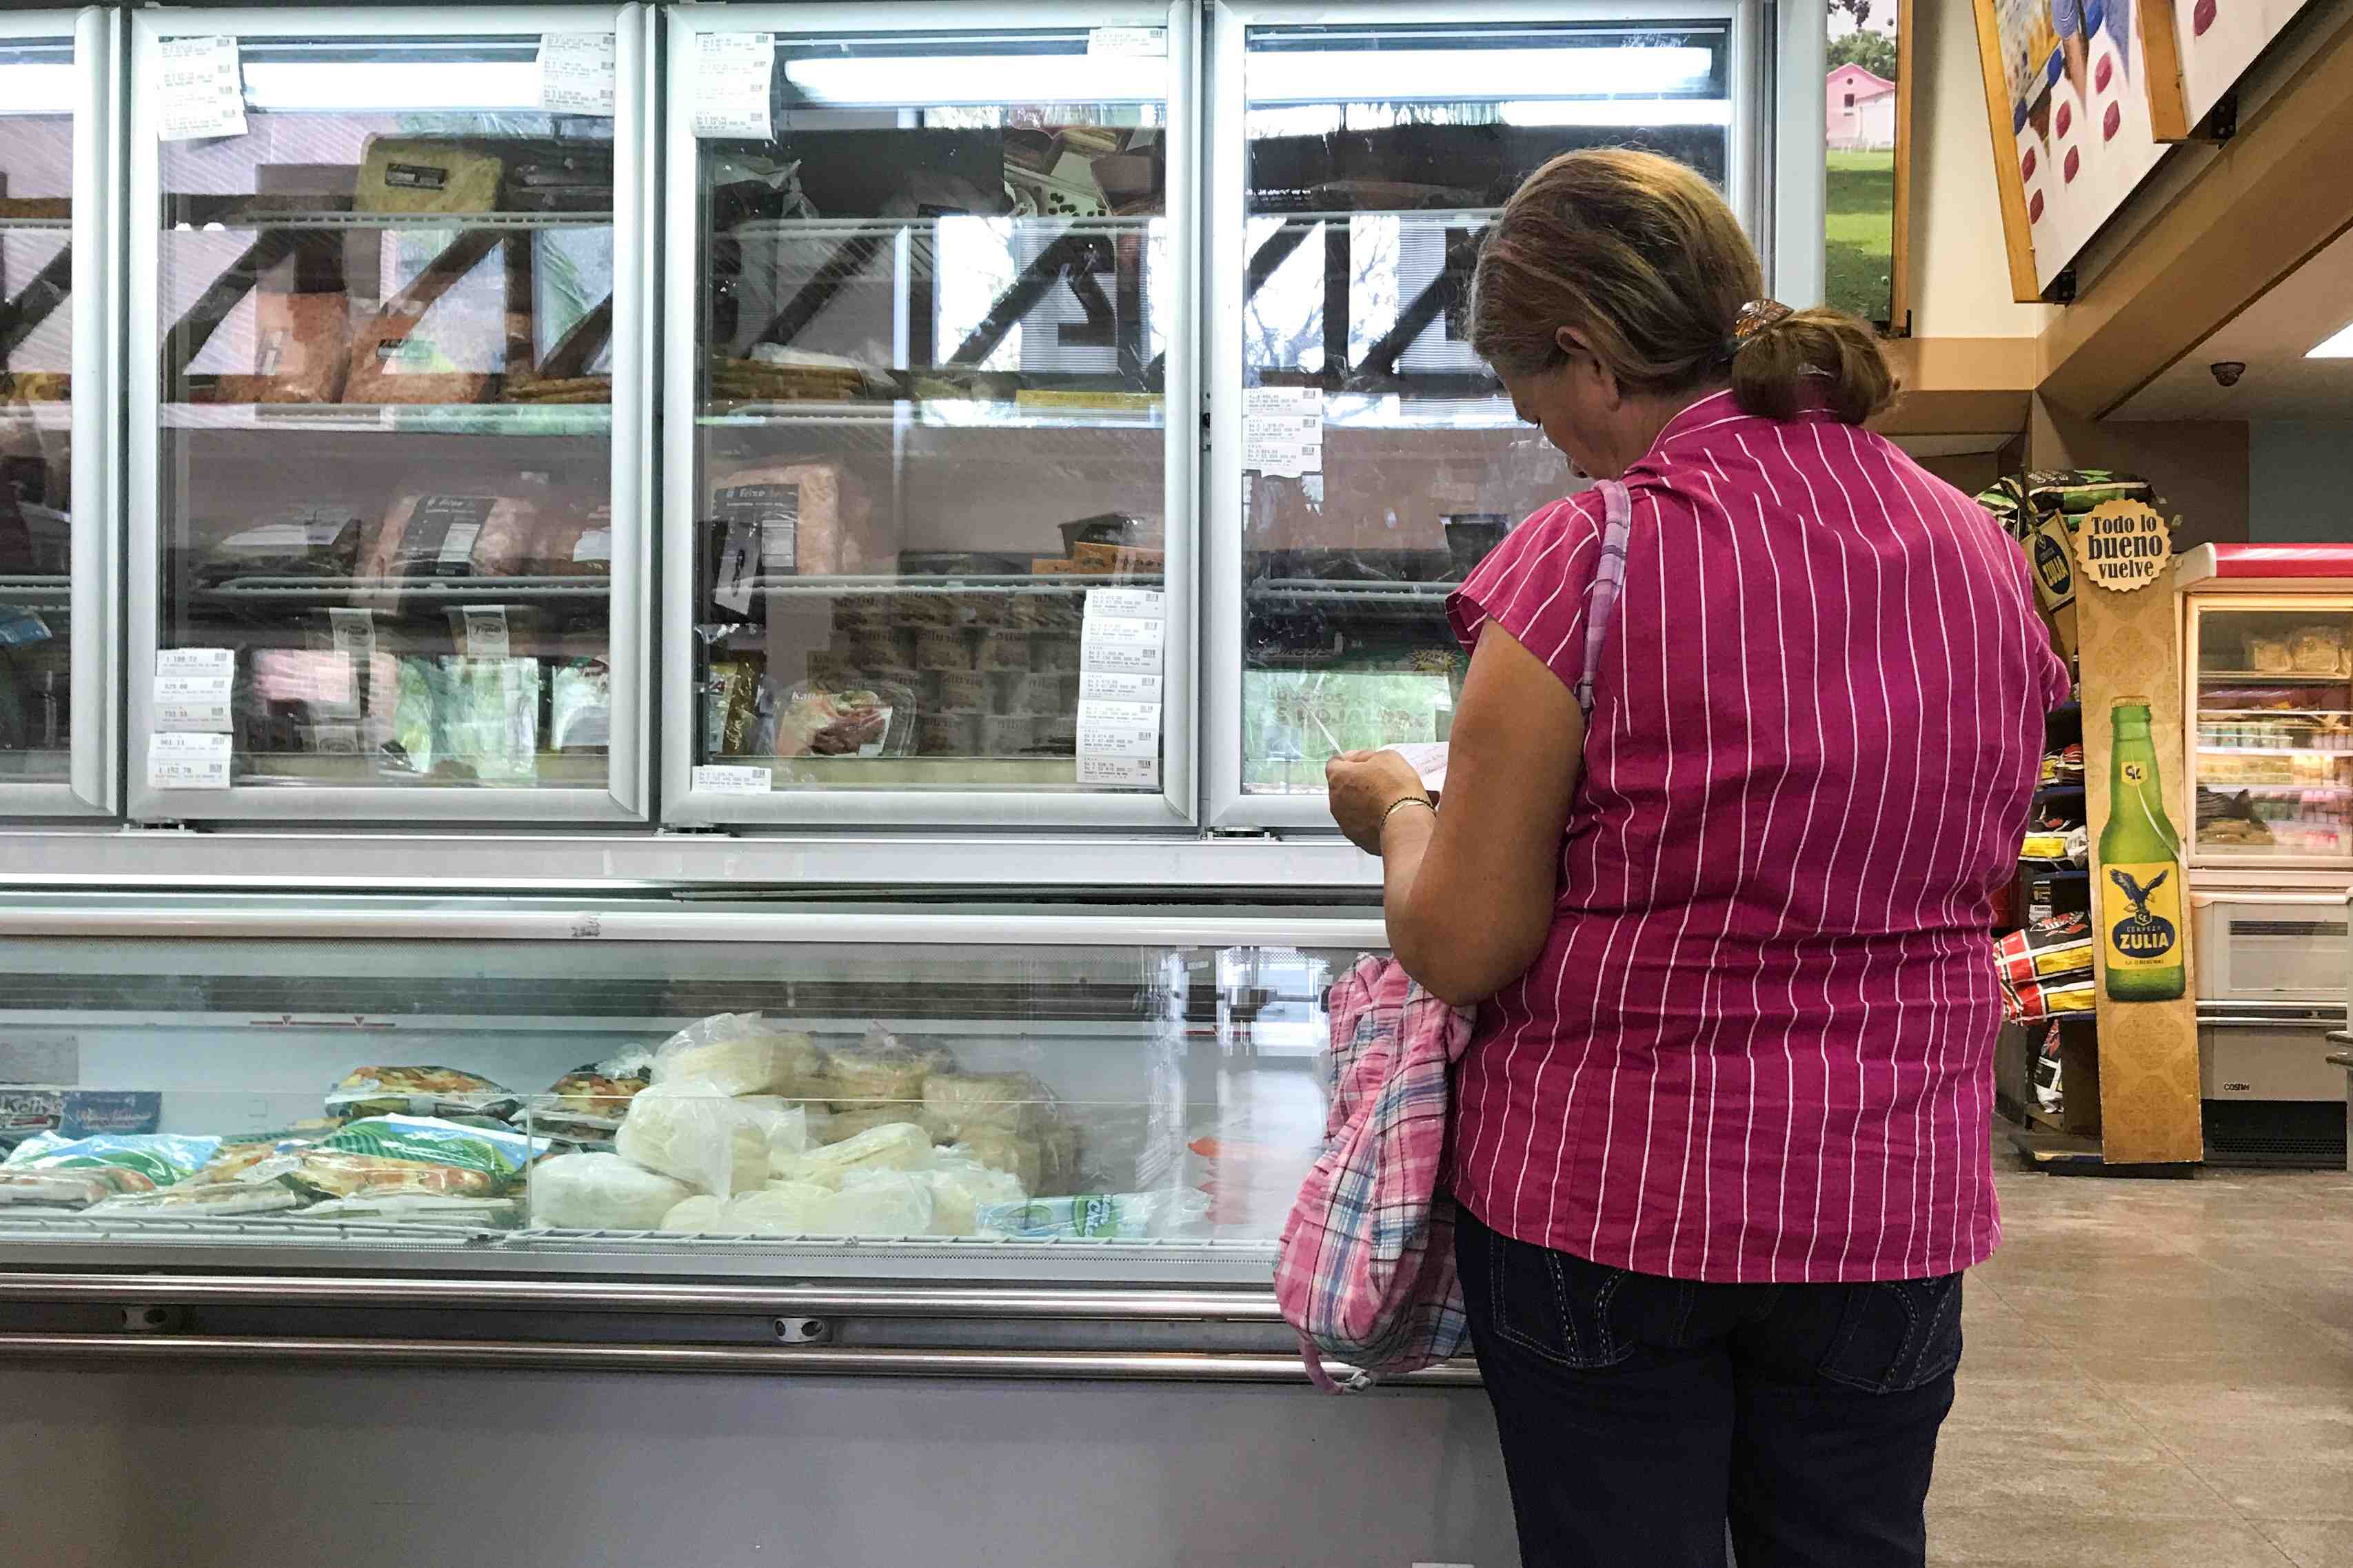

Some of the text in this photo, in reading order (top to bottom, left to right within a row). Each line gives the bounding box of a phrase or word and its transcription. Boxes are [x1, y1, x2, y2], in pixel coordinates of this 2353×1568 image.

[2091, 513, 2157, 535] Todo lo
[2088, 534, 2163, 560] bueno
[2098, 559, 2154, 580] vuelve
[2119, 932, 2170, 949] ZULIA
